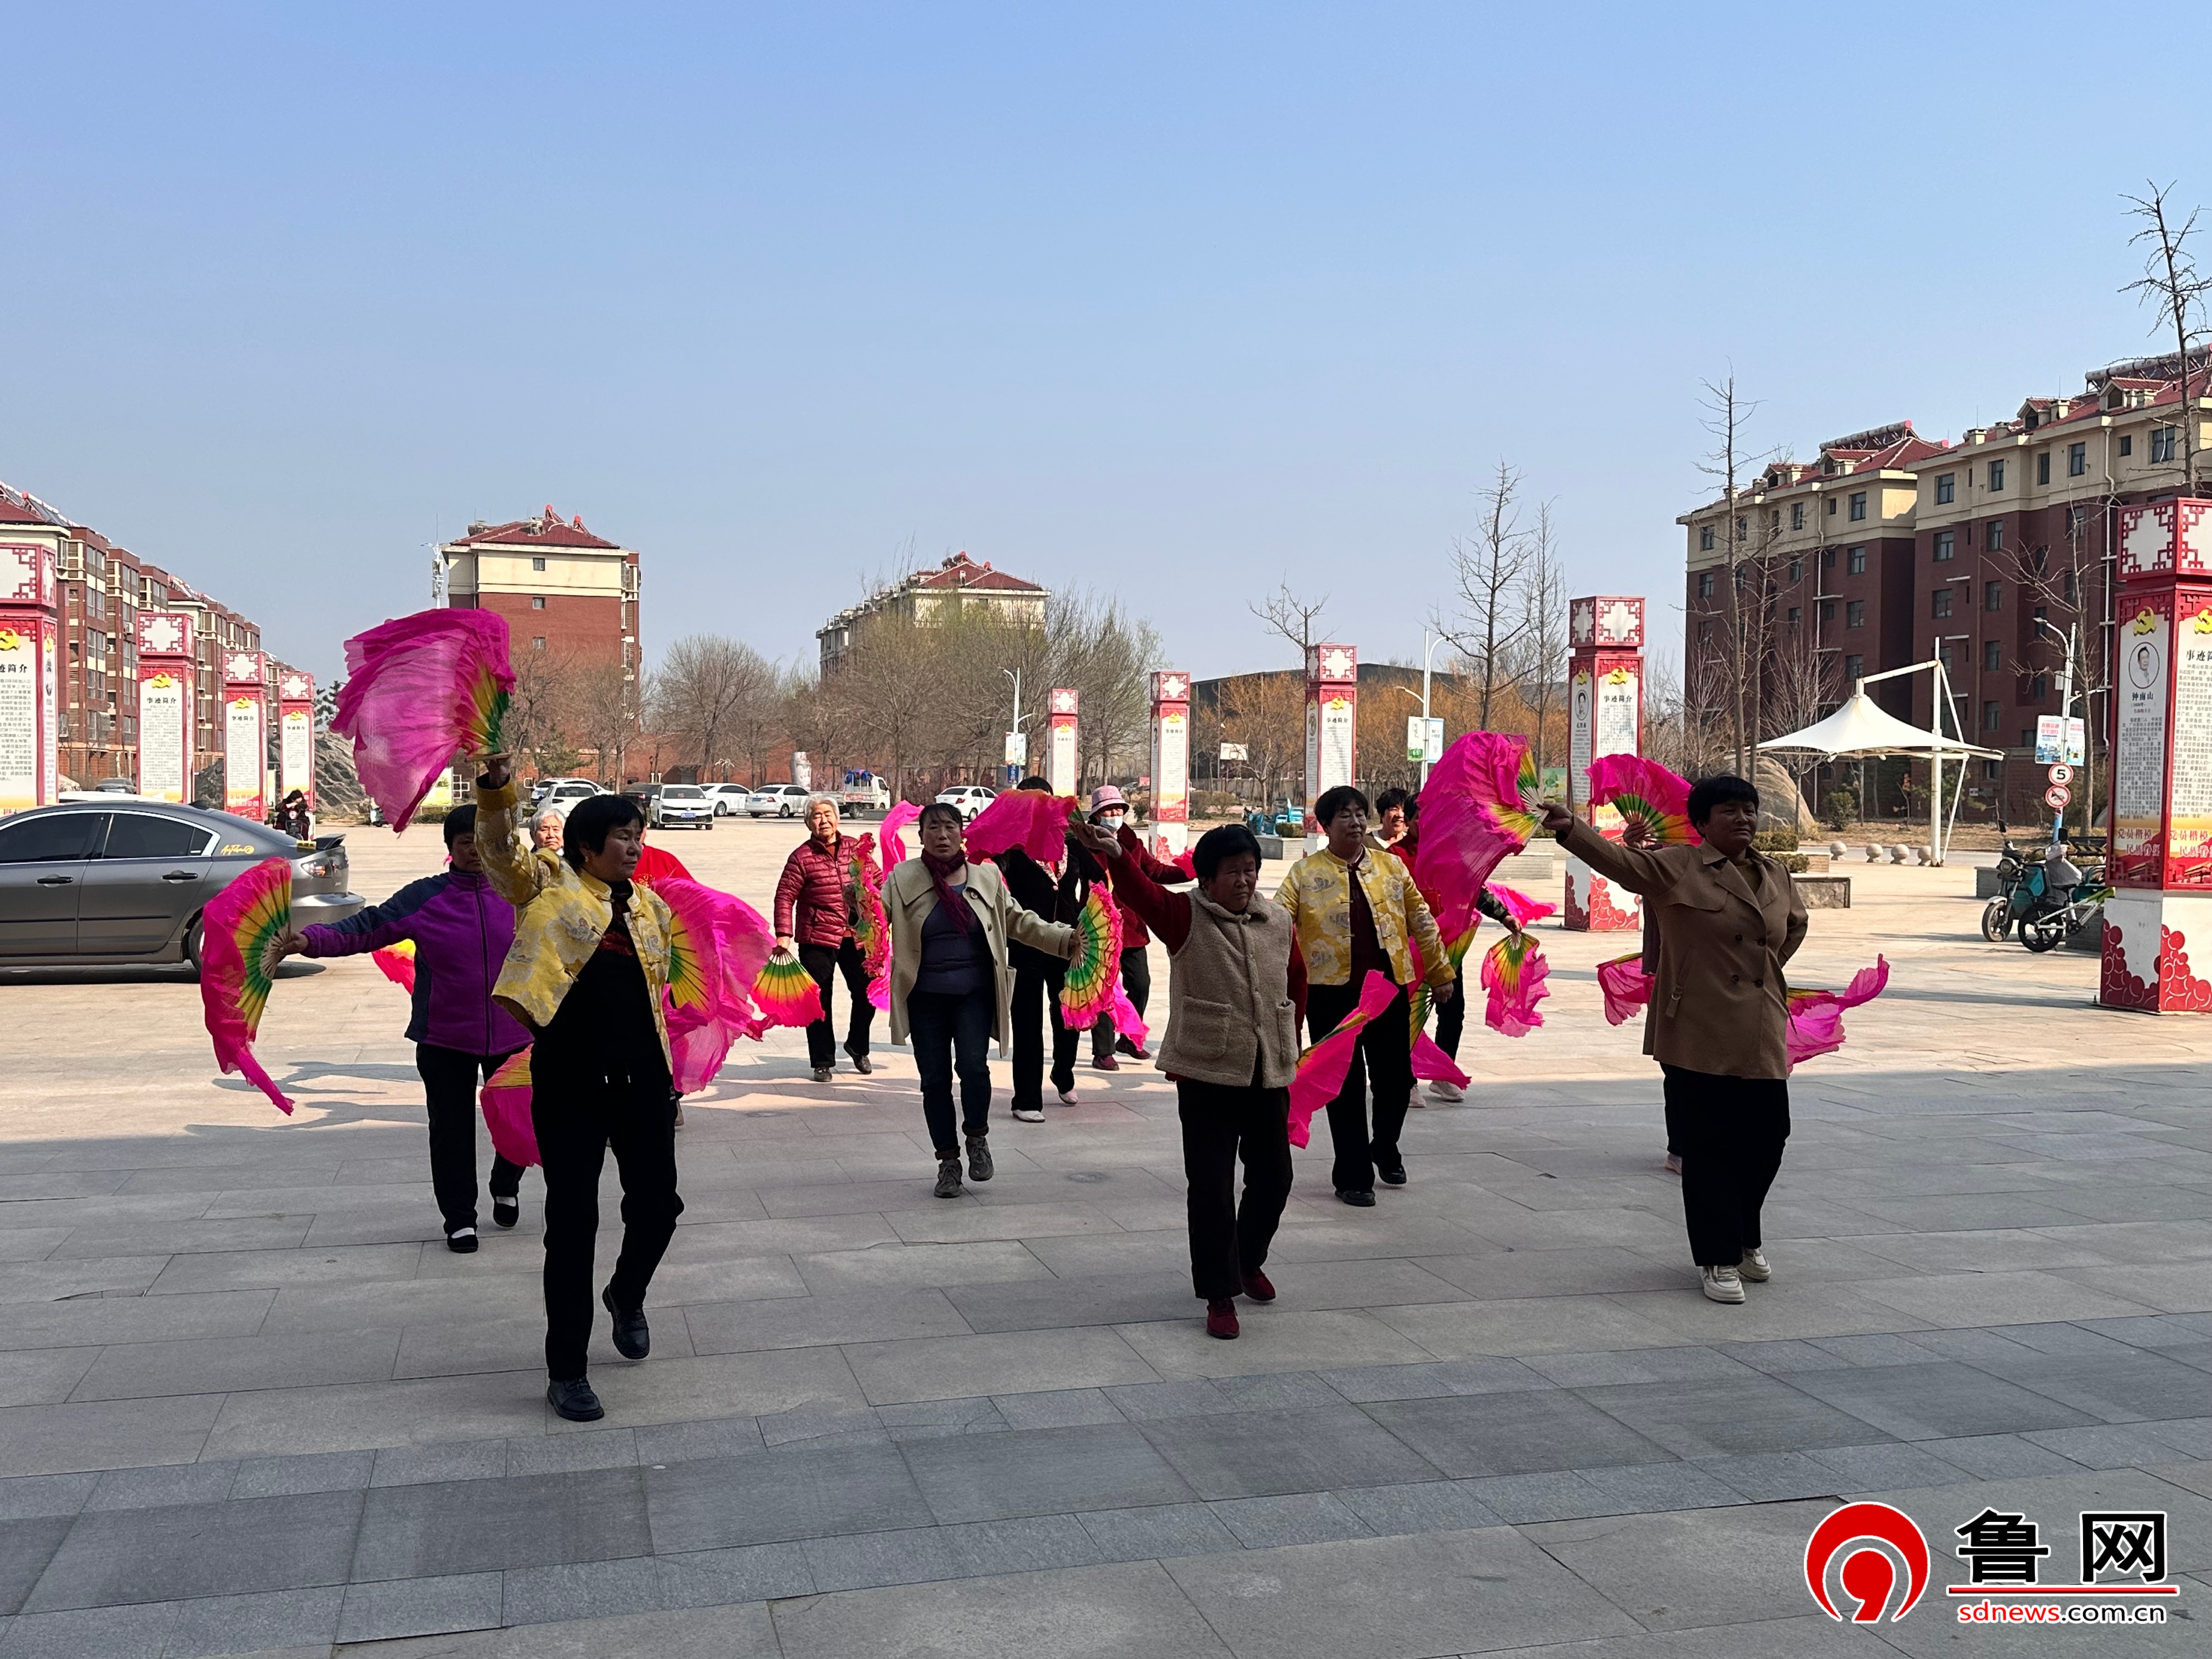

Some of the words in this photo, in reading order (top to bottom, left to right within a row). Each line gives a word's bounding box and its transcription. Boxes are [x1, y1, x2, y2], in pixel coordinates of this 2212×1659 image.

[1604, 695, 1633, 703] 事迹简介
[2056, 769, 2066, 780] 5
[2118, 827, 2152, 841] 党员楷模
[2180, 844, 2212, 858] 民族脊
